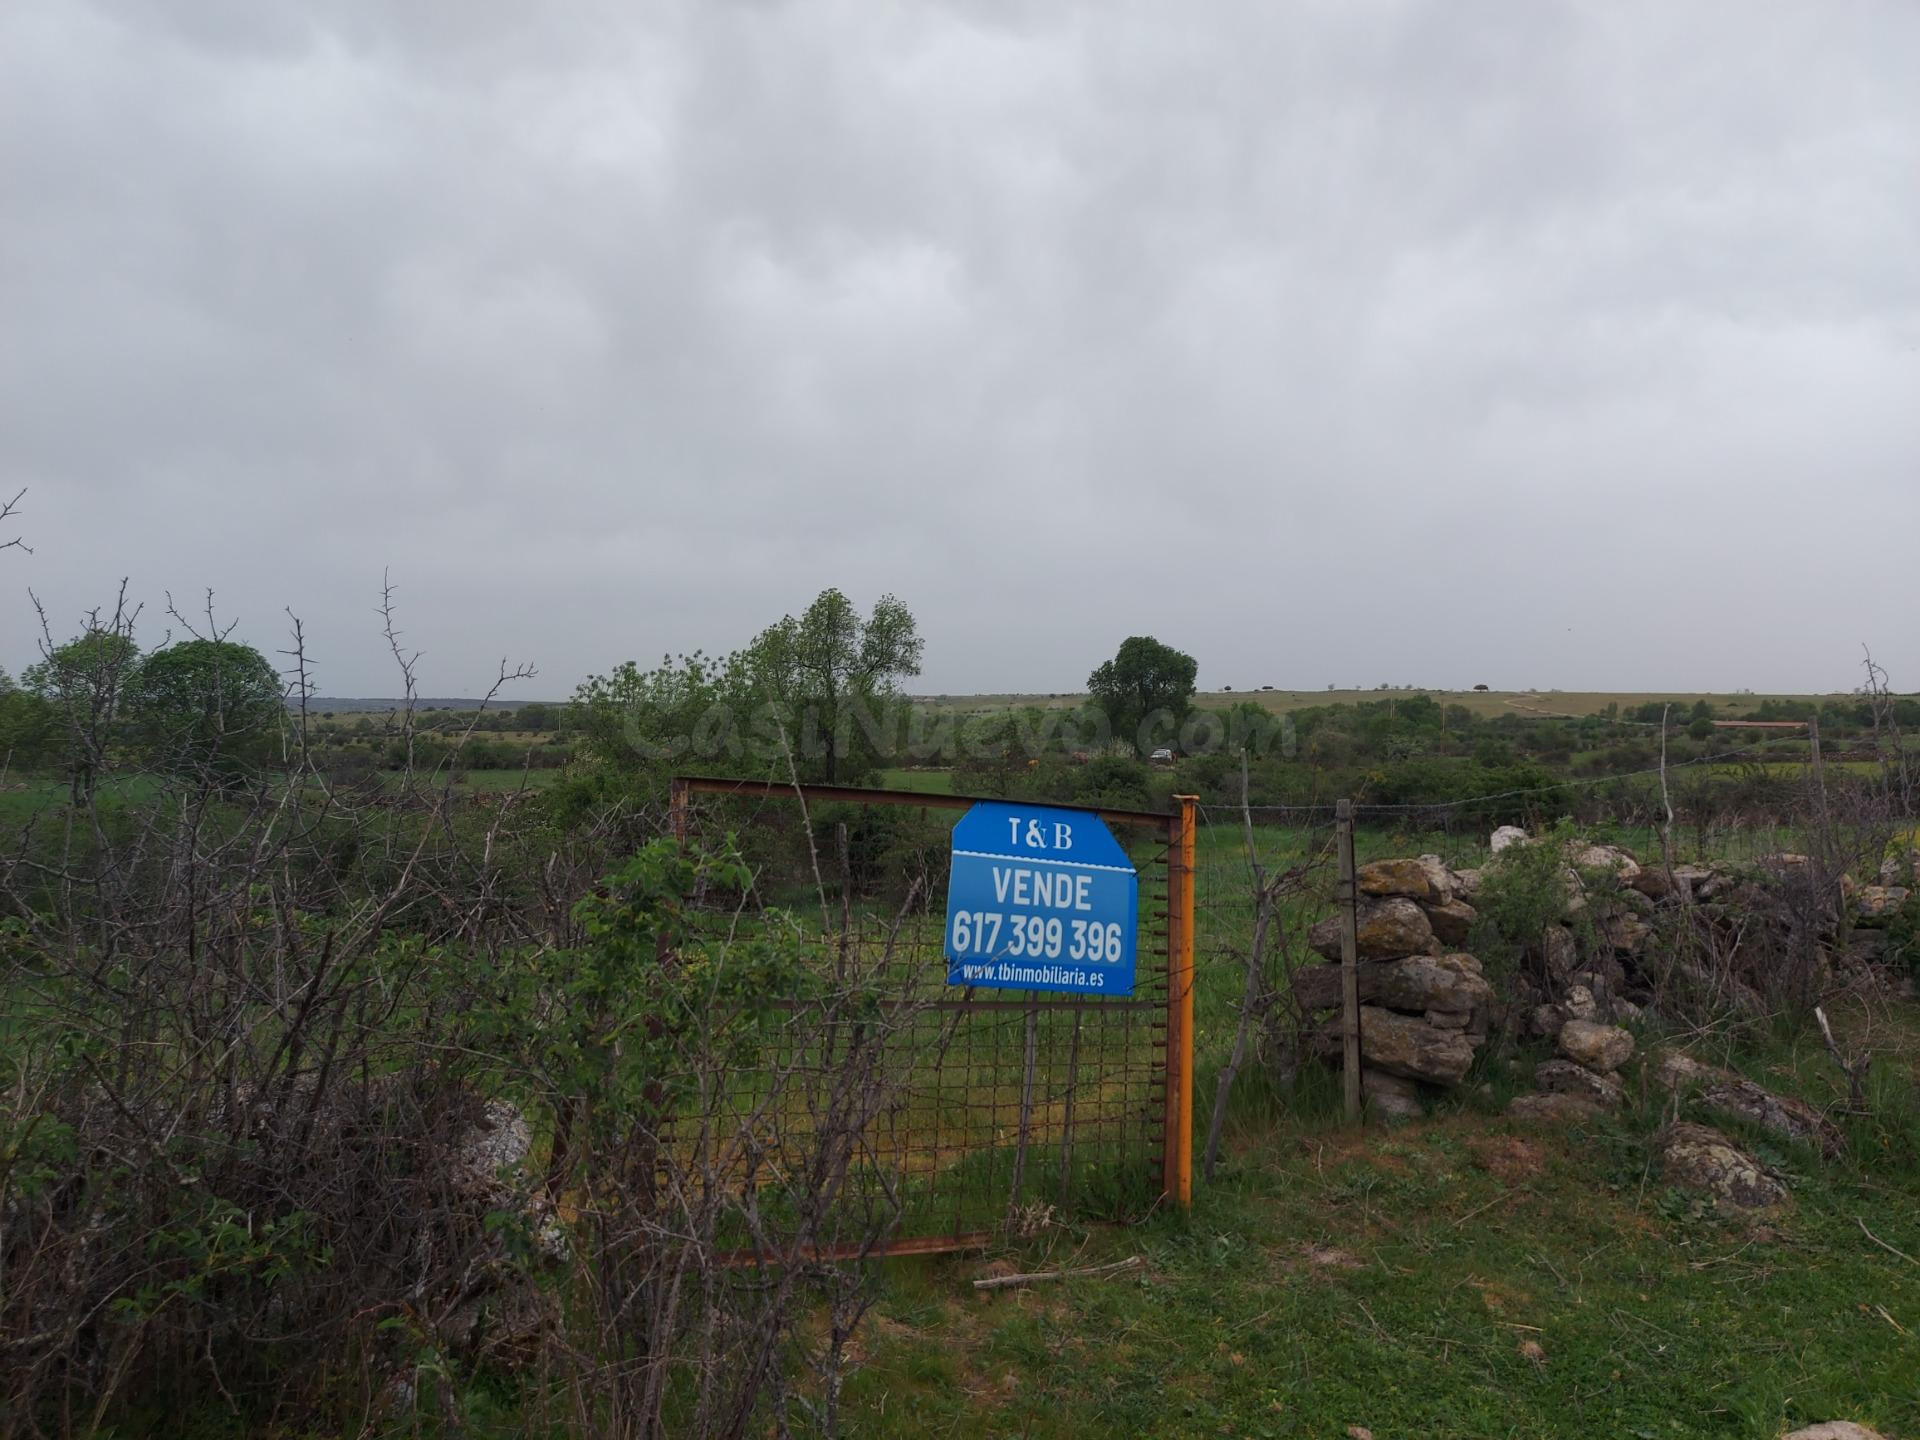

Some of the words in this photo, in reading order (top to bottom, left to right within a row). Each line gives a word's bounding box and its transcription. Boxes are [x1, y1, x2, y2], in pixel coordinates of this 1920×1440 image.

[1008, 817, 1021, 845] T
[1025, 819, 1048, 848] &
[1053, 822, 1073, 850] B
[992, 867, 1092, 910] VENDE
[952, 910, 1003, 953] 617
[1008, 915, 1063, 958] 399
[1069, 920, 1122, 963] 396
[963, 963, 1104, 987] www.tbinmobiliaria.es
